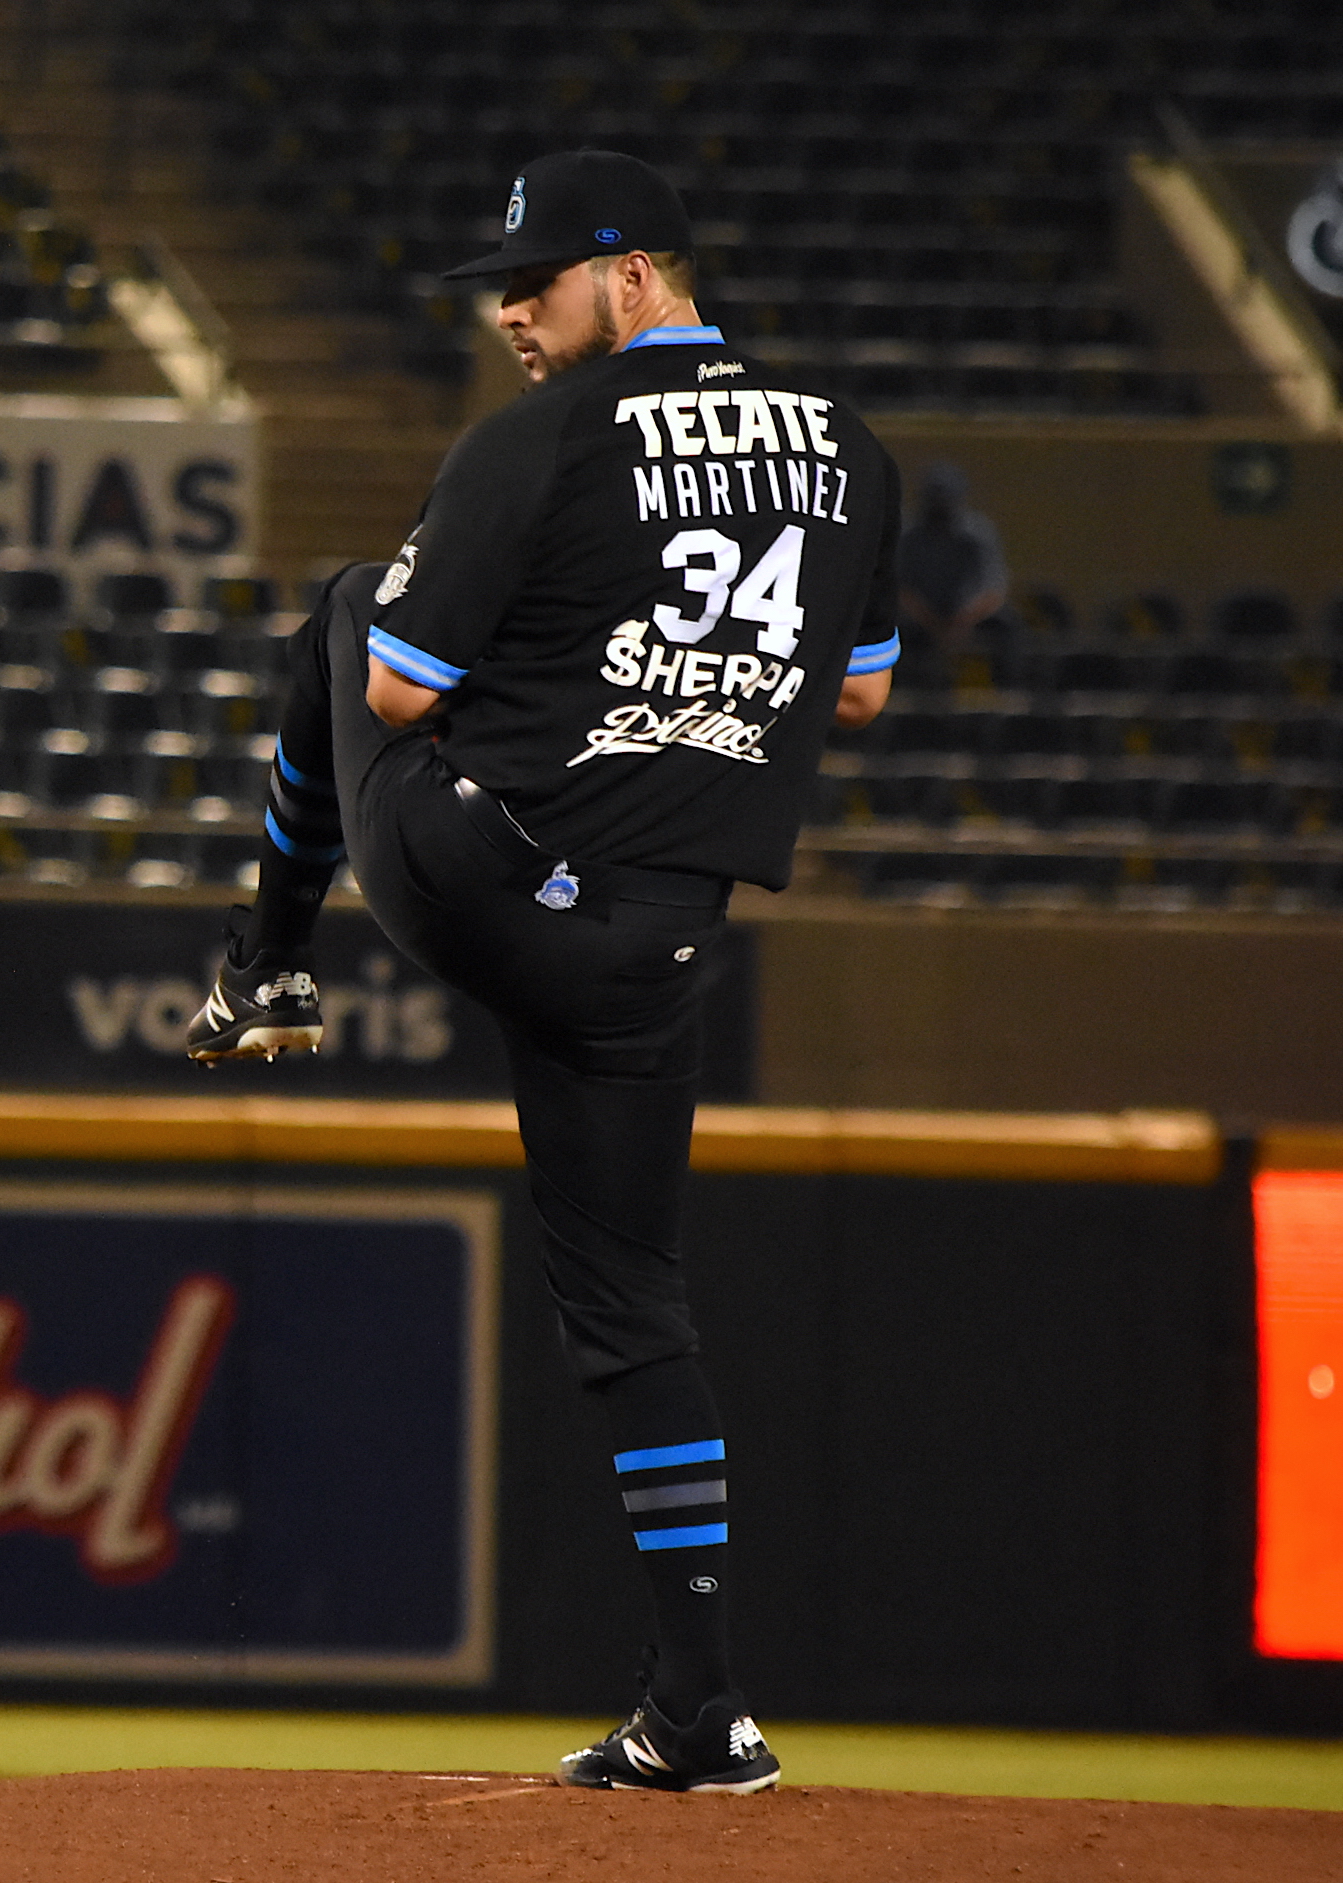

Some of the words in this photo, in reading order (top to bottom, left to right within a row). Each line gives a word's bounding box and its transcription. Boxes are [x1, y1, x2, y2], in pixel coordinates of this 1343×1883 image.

[614, 389, 839, 458] TECATE
[632, 459, 848, 524] MARTINEZ
[652, 524, 805, 660] 34
[599, 620, 805, 709] SHERPA
[69, 950, 455, 1062] voris
